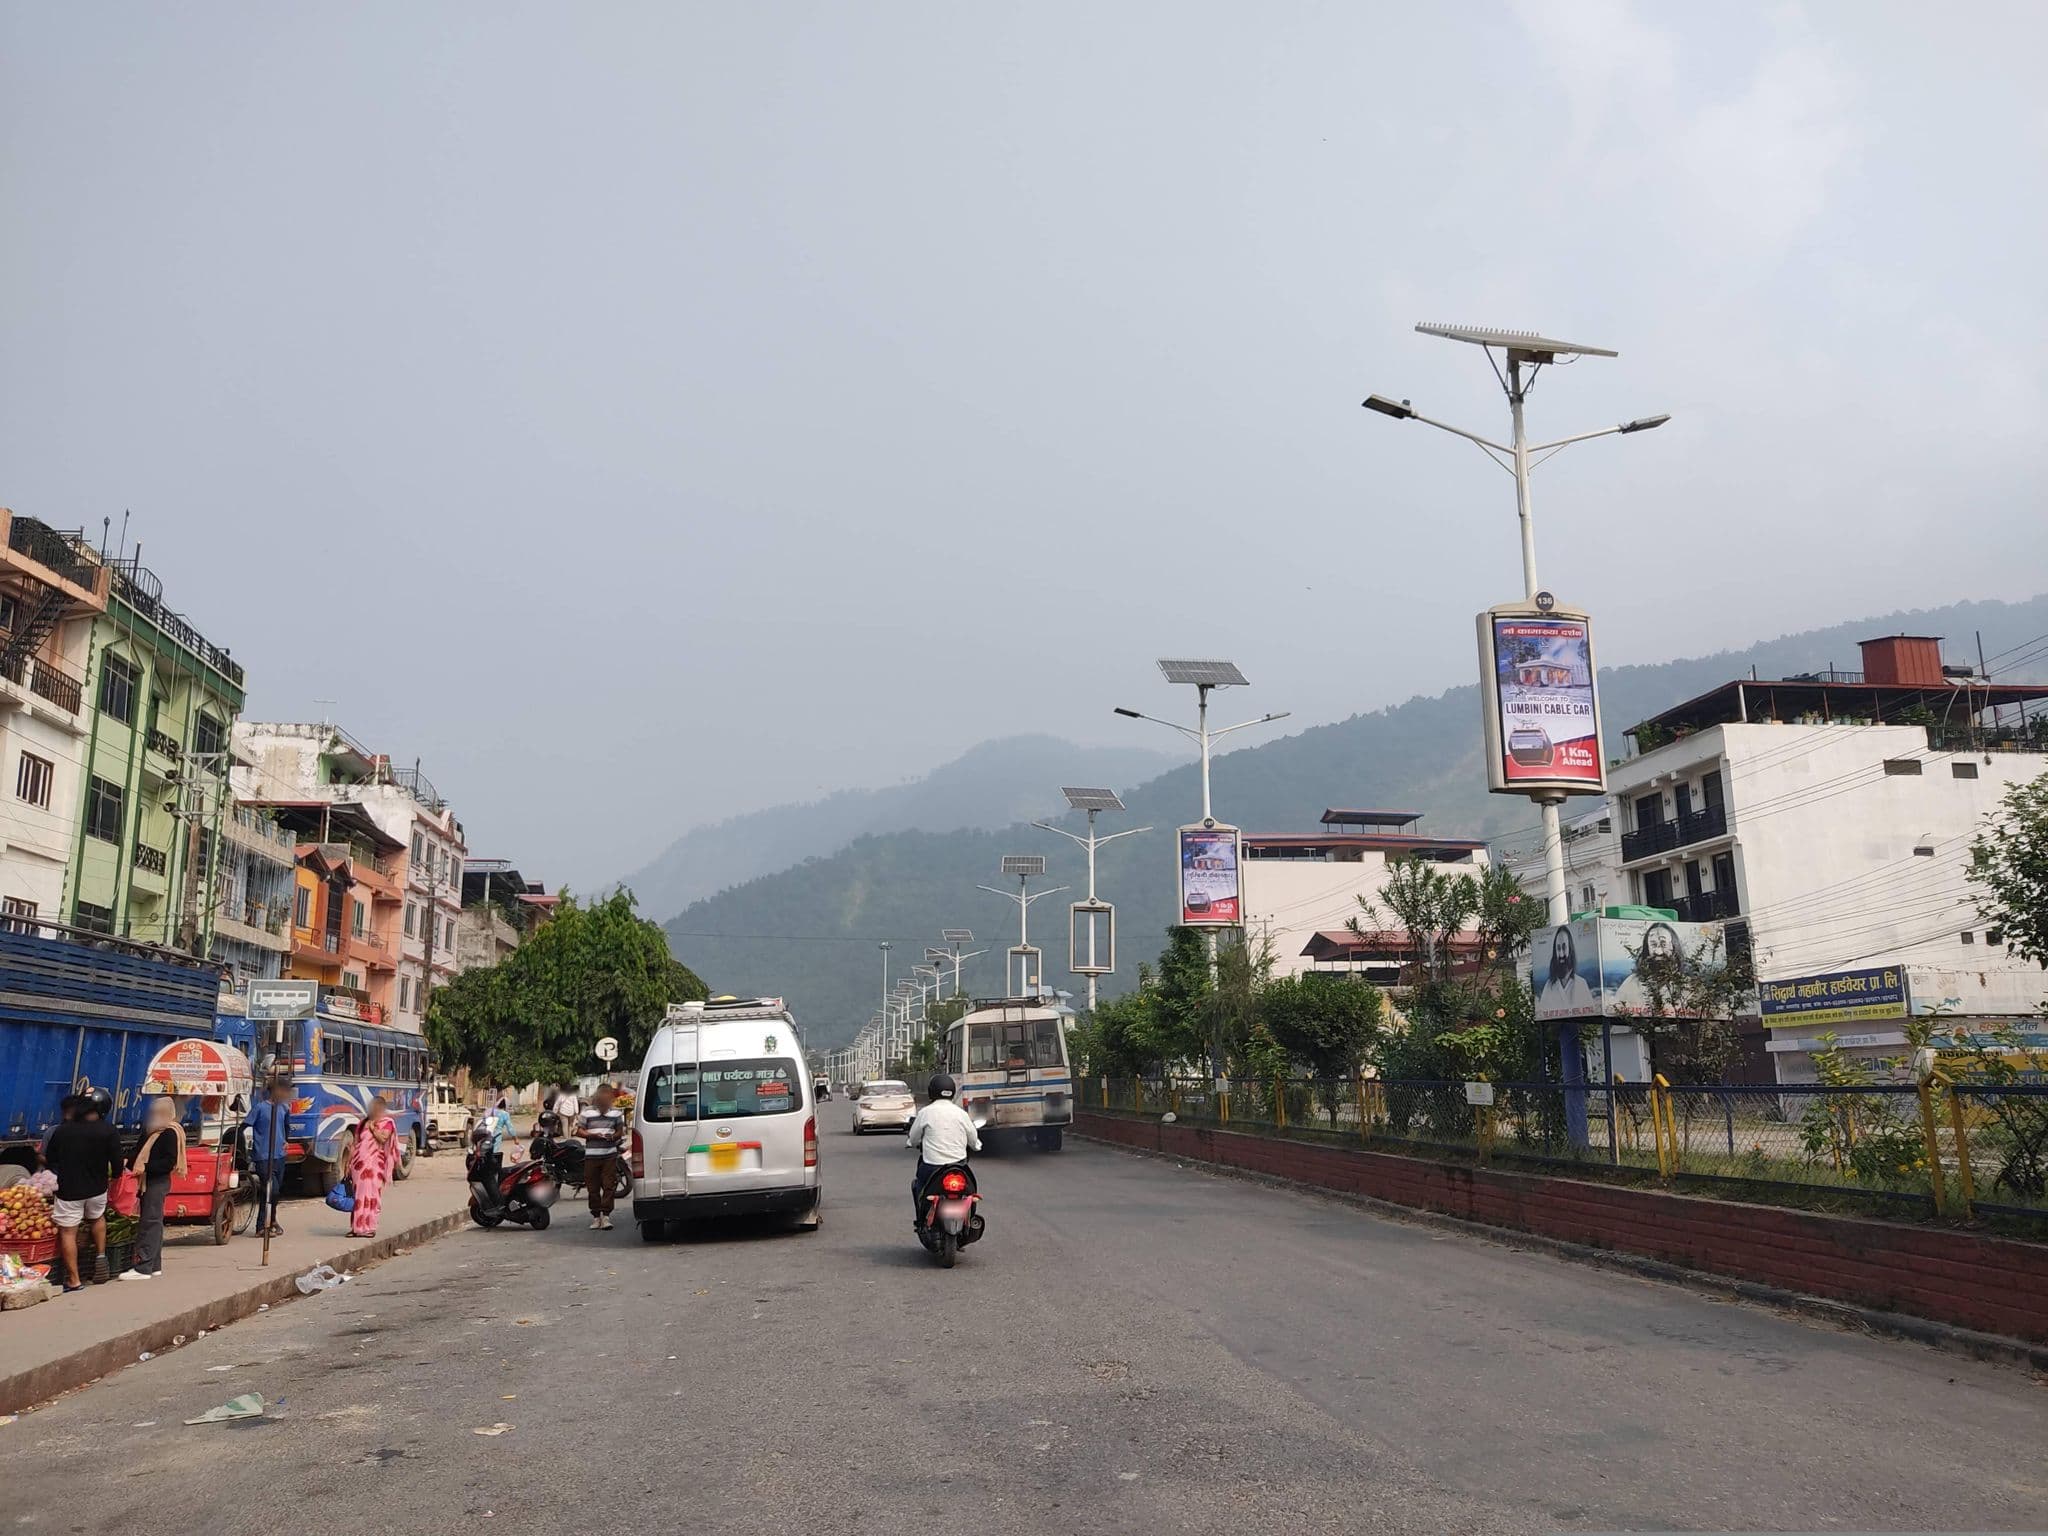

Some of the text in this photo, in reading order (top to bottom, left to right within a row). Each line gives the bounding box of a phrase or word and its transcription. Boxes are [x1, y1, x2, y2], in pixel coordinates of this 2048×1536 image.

[1506, 703, 1590, 715] LUMBINI CABLE CAR
[1560, 747, 1566, 756] 1
[1563, 757, 1593, 766] Ahead
[1798, 980, 1828, 998] महावीर
[604, 1042, 616, 1057] P
[702, 1071, 722, 1082] ONLY
